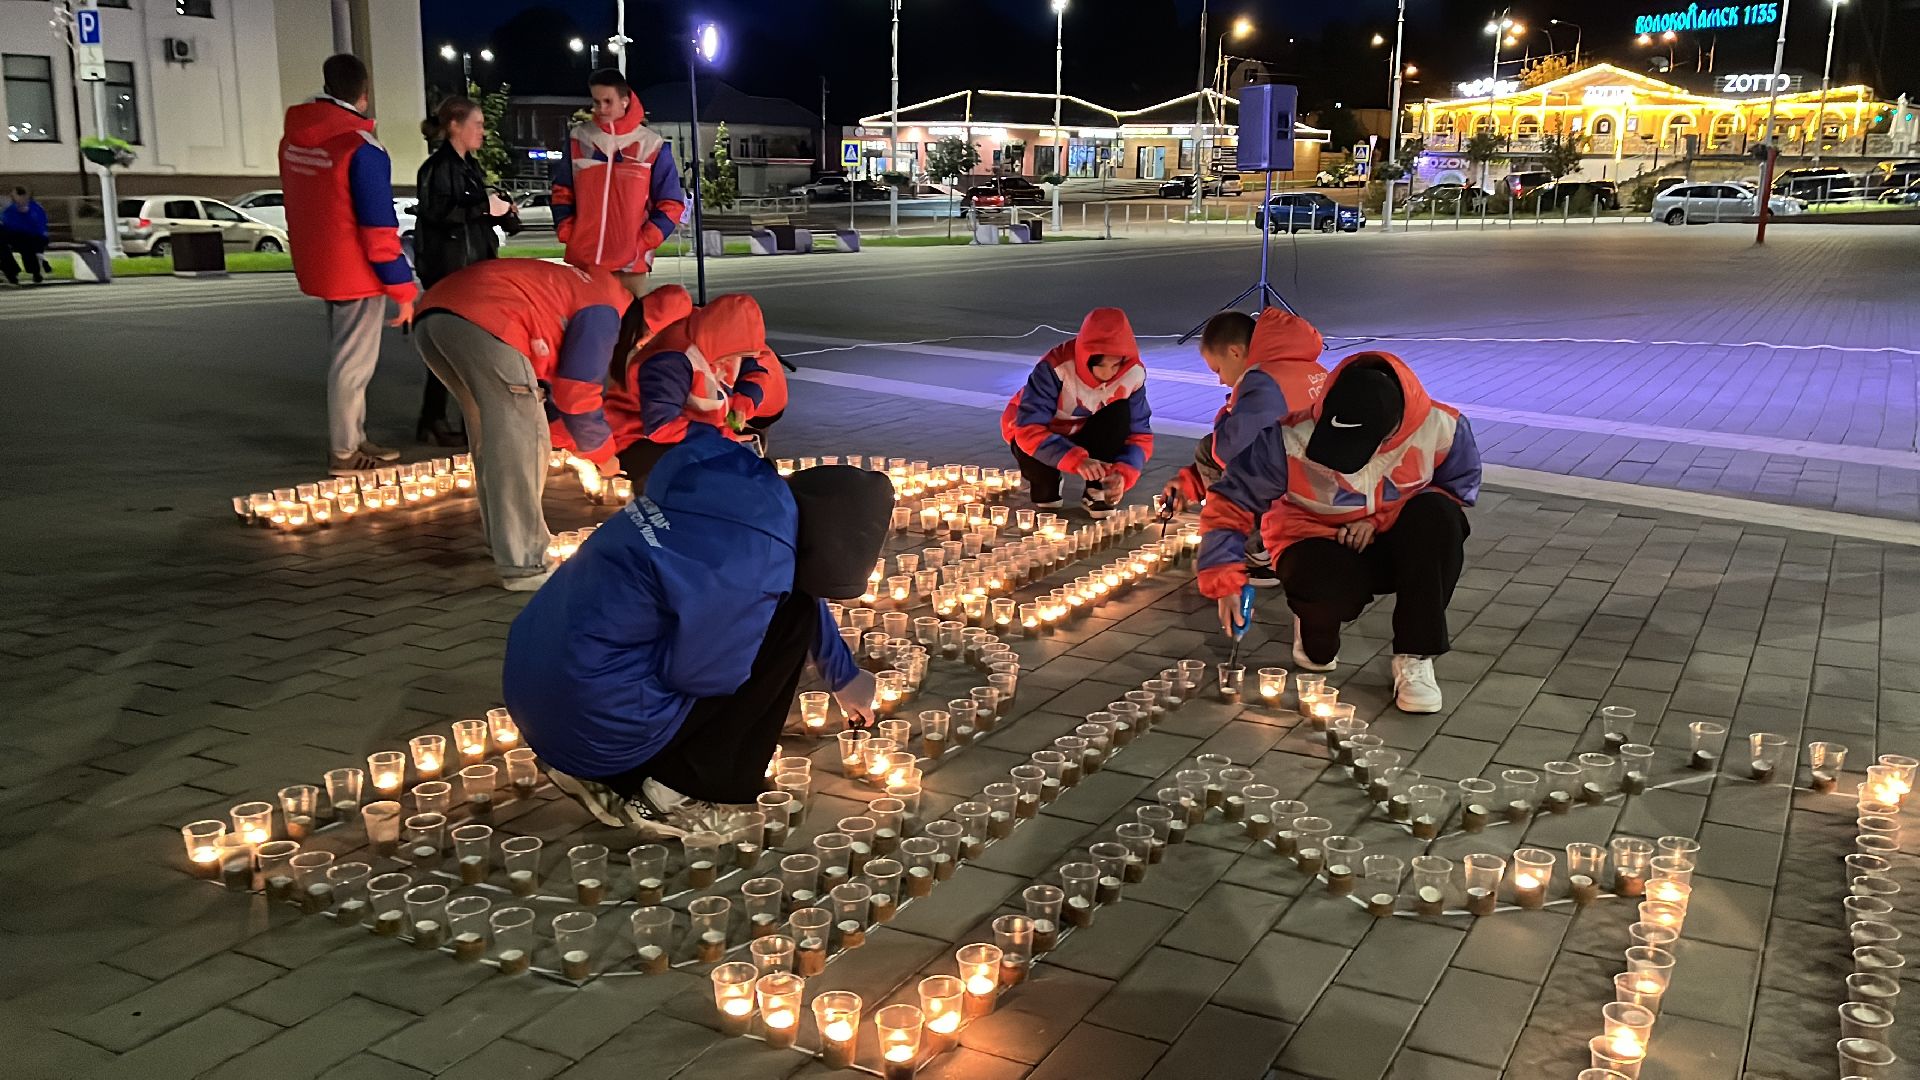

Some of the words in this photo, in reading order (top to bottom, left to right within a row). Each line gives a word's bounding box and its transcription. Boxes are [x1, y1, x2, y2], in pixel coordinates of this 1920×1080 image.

[1744, 3, 1778, 25] 1135
[1723, 73, 1791, 92] ZOTTO
[1430, 159, 1471, 169] OZON
